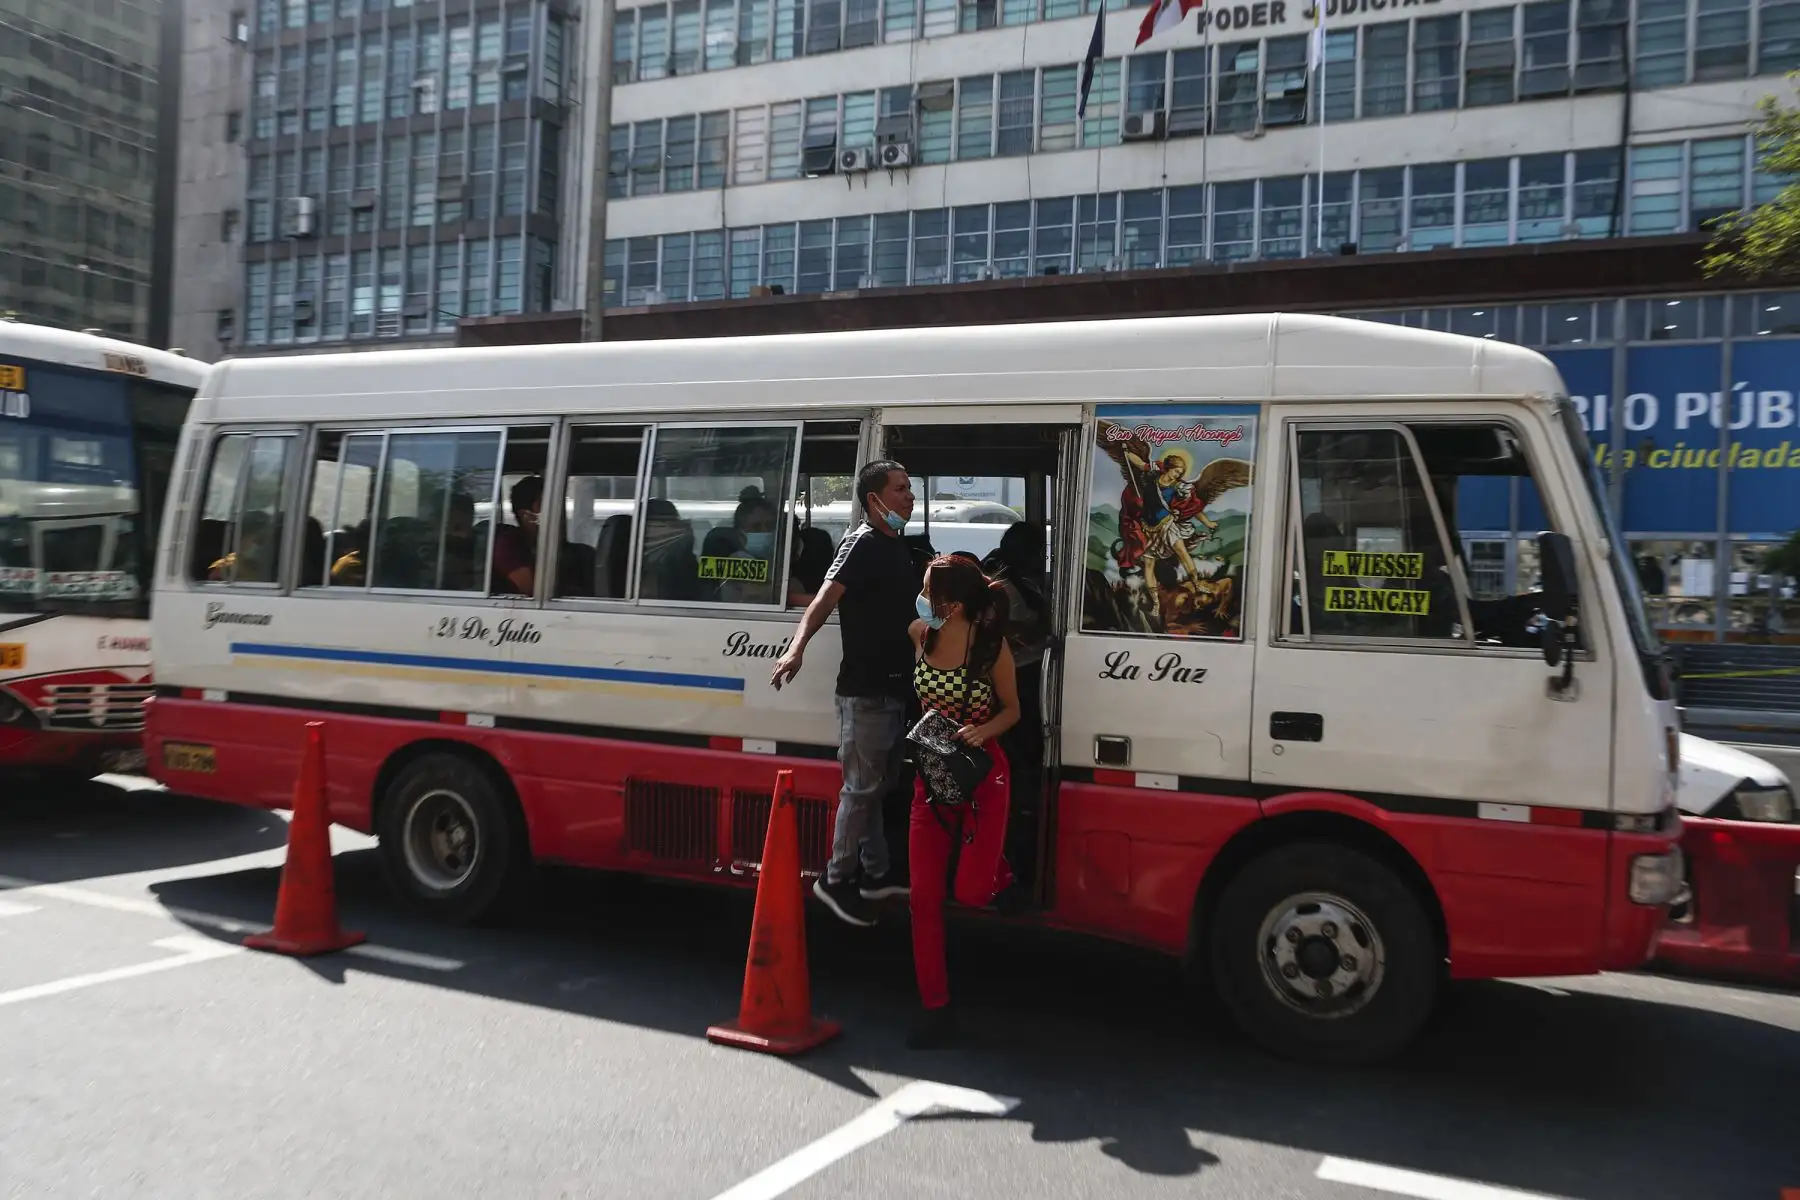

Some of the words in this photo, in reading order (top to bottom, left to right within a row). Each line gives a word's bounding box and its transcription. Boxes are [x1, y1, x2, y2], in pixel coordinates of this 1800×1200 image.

[1197, 2, 1286, 34] PODER
[1302, 0, 1442, 19] JUDI
[1675, 381, 1800, 431] PÚB
[1105, 423, 1133, 441] San
[1135, 423, 1184, 447] Miguel
[715, 559, 766, 580] WIESSE
[1345, 552, 1419, 577] WIESSE
[1329, 589, 1426, 613] ABANCAY
[460, 616, 490, 640] De
[489, 618, 542, 647] Julio
[722, 631, 794, 659] Brasil
[1098, 650, 1140, 680] La
[1148, 652, 1209, 684] Paz
